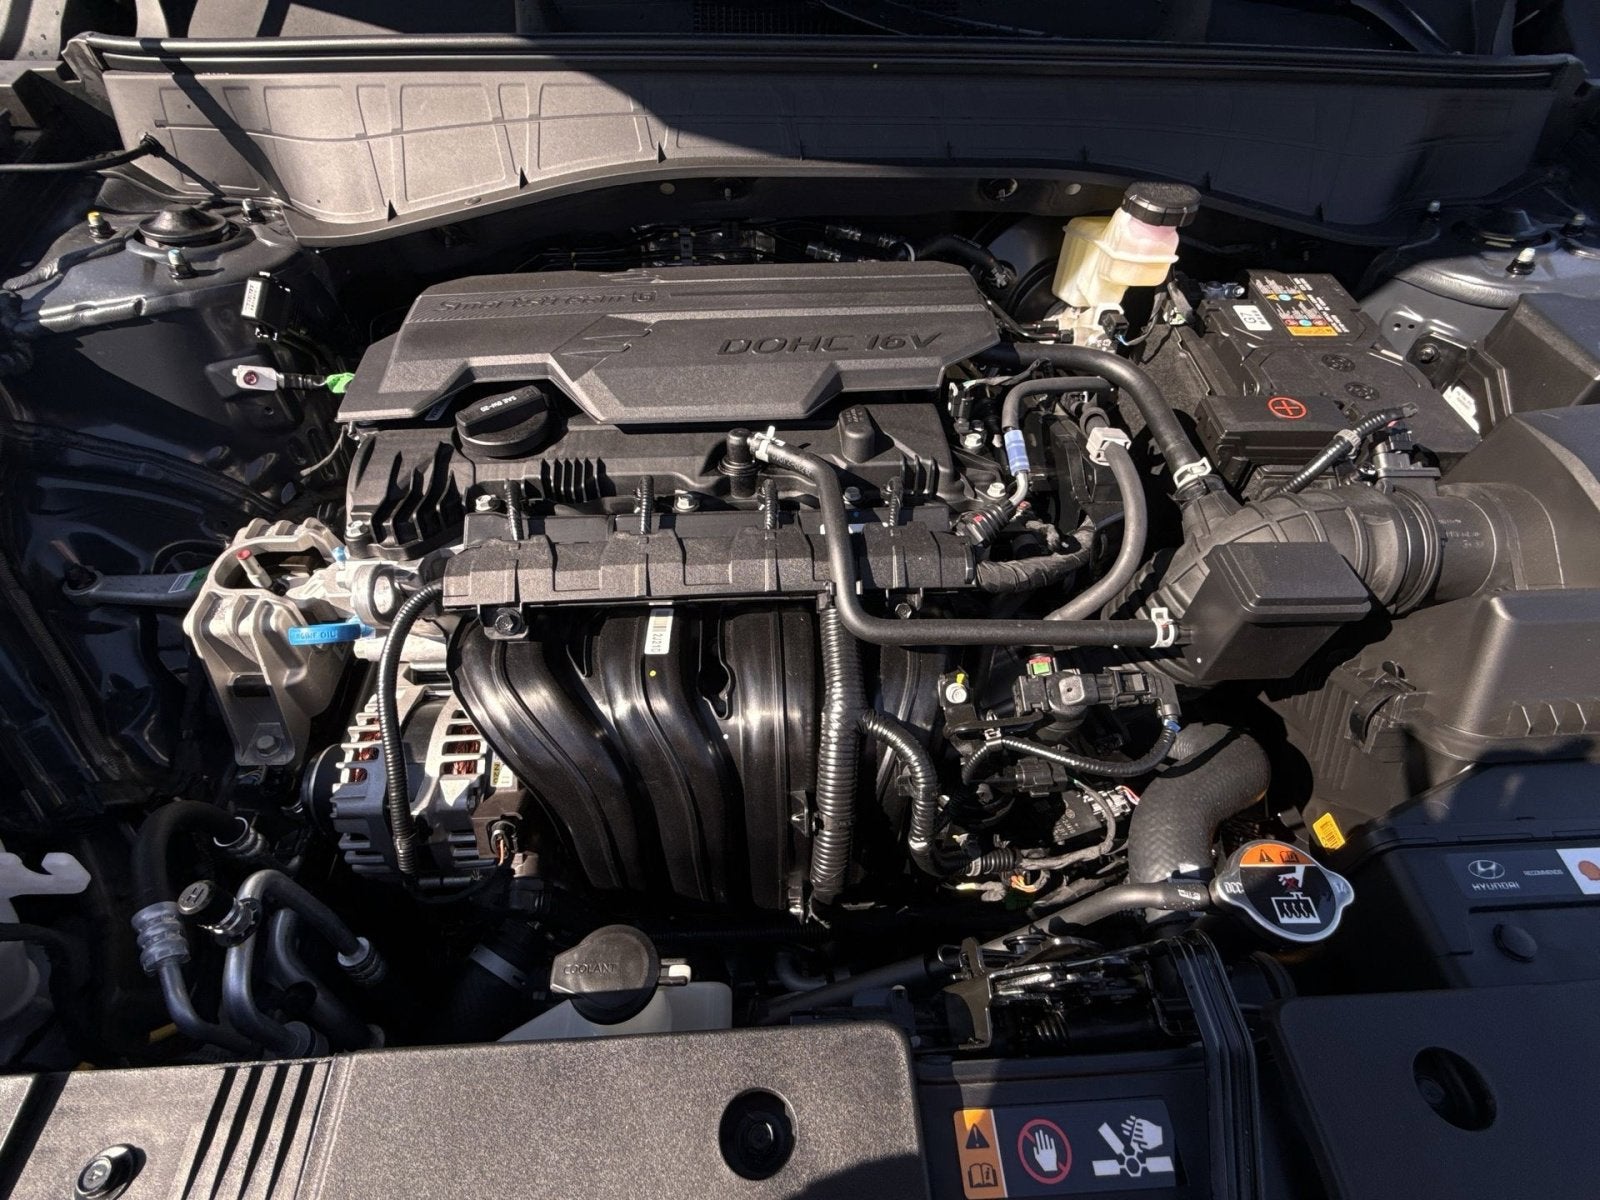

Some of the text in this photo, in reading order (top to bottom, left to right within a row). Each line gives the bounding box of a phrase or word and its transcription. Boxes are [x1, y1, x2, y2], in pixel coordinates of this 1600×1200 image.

[716, 332, 942, 356] DOHC 16V
[320, 631, 336, 639] OIL
[1471, 881, 1520, 891] HYUNDAI
[563, 961, 618, 975] COOLANT
